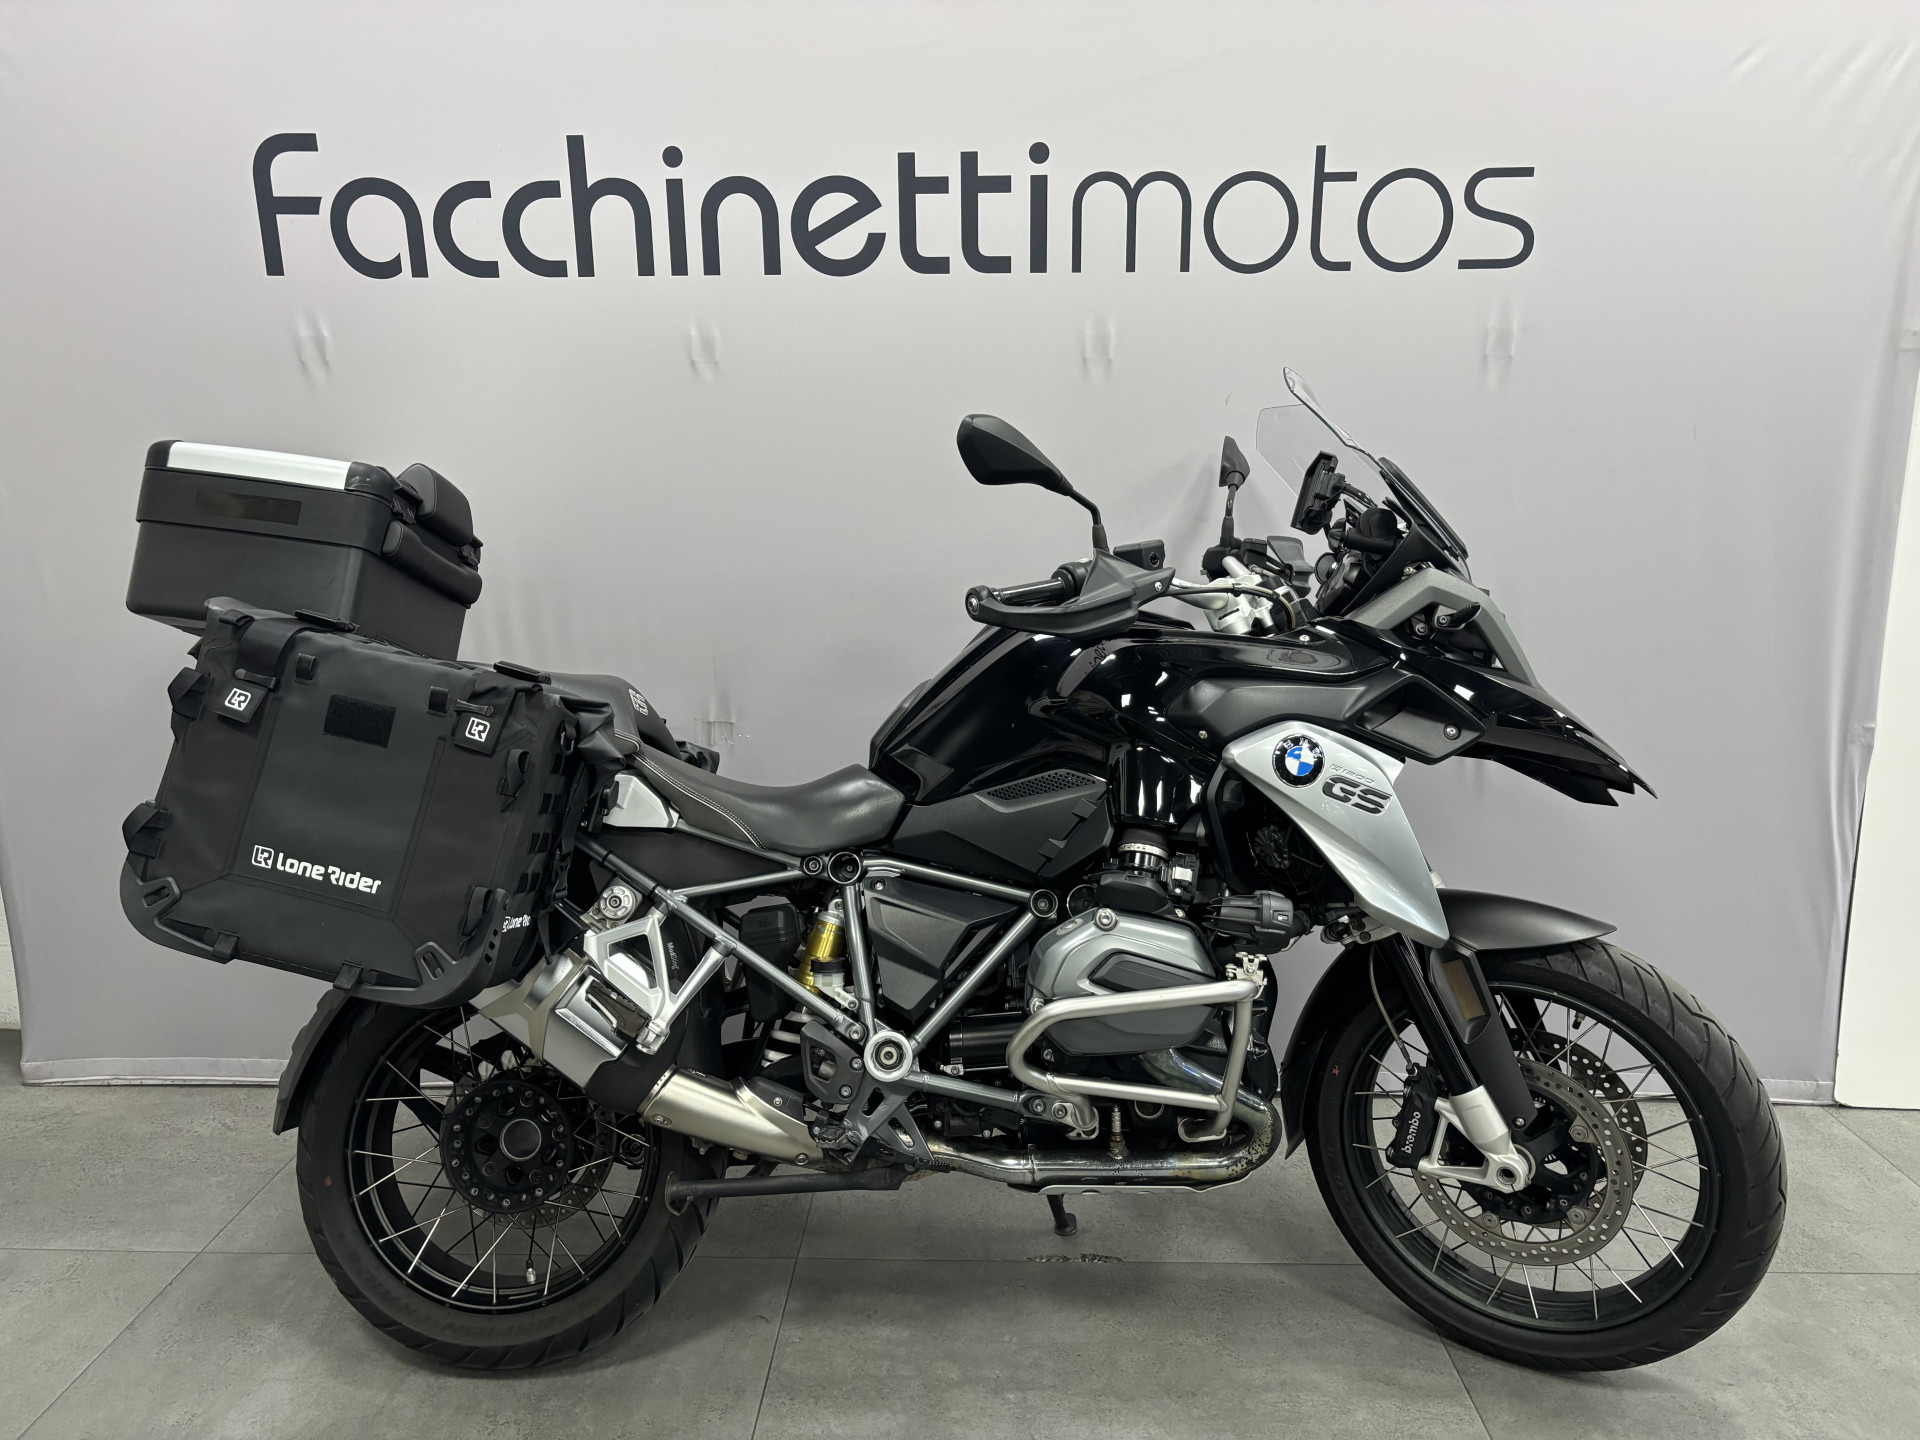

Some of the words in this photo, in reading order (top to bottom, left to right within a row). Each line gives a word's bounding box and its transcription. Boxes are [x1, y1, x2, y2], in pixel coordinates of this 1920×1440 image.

[1321, 774, 1393, 816] GS
[276, 852, 326, 881] Lone
[327, 865, 382, 894] Rider
[1401, 1111, 1421, 1154] brembo
